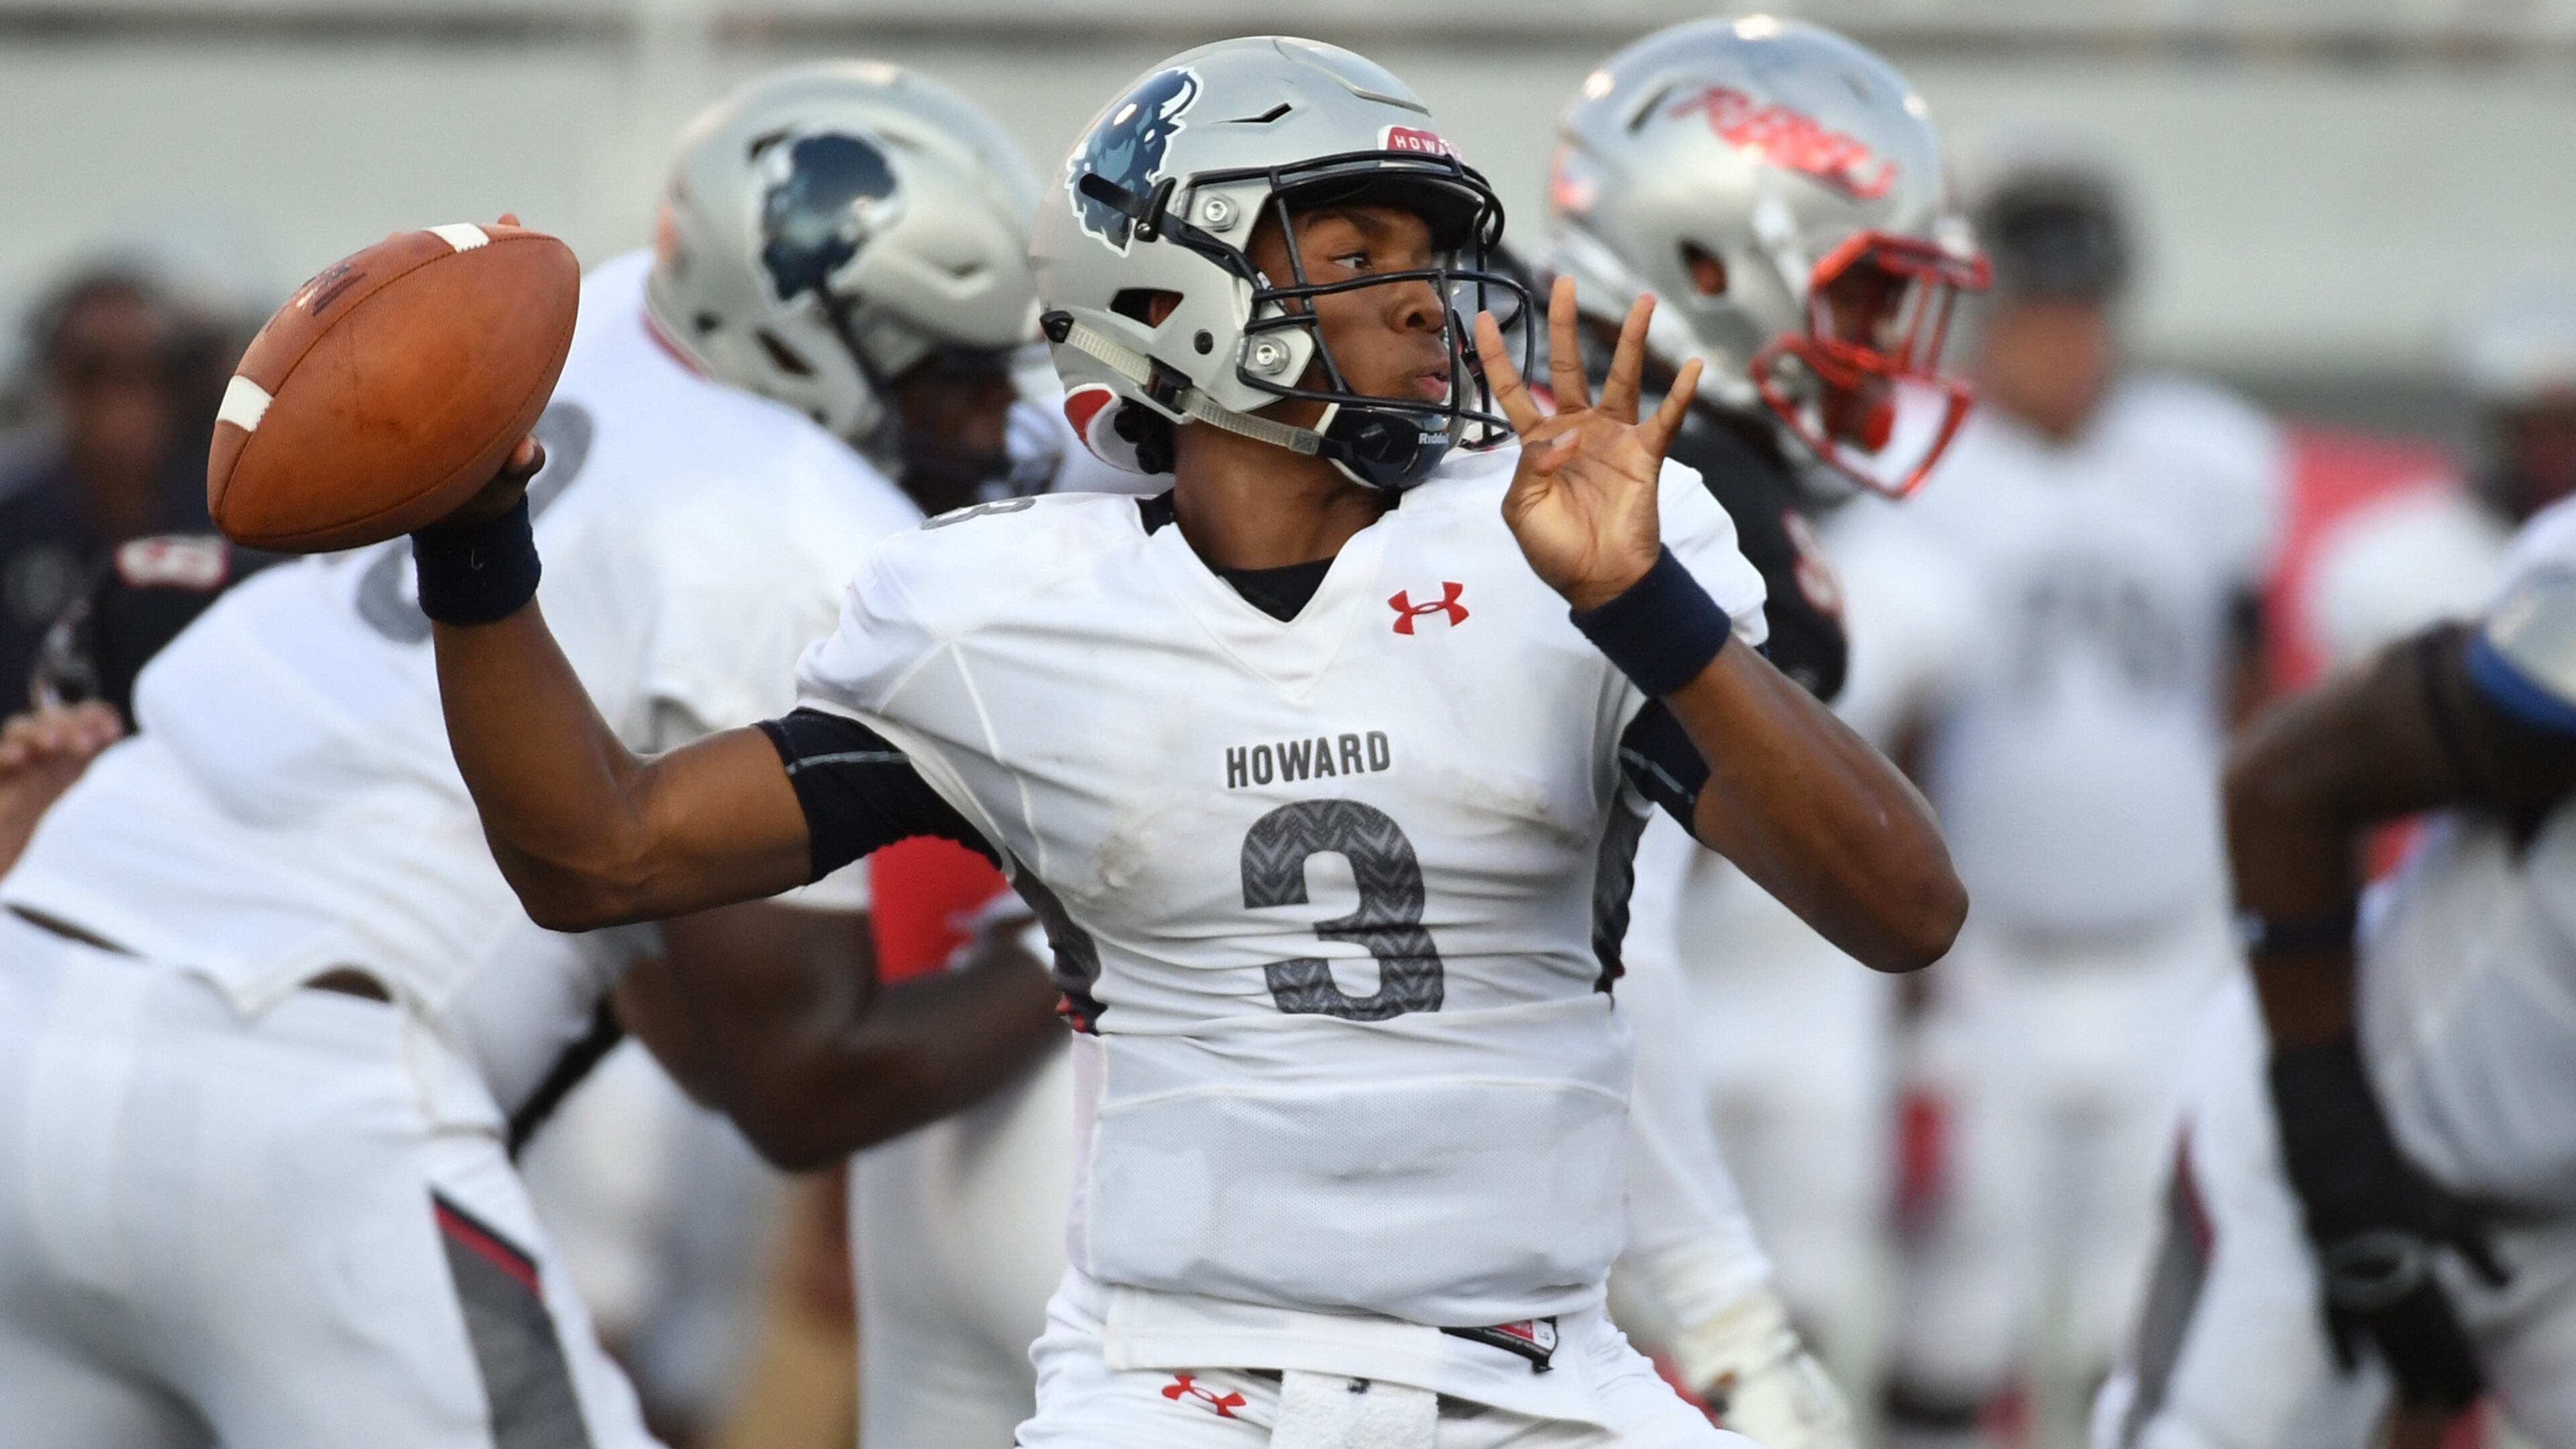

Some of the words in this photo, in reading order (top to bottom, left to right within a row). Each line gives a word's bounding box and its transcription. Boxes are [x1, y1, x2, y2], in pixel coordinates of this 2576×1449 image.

[1393, 135, 1462, 161] HOWA
[1226, 731, 1391, 789] HOWARD
[1240, 798, 1444, 1022] 3
